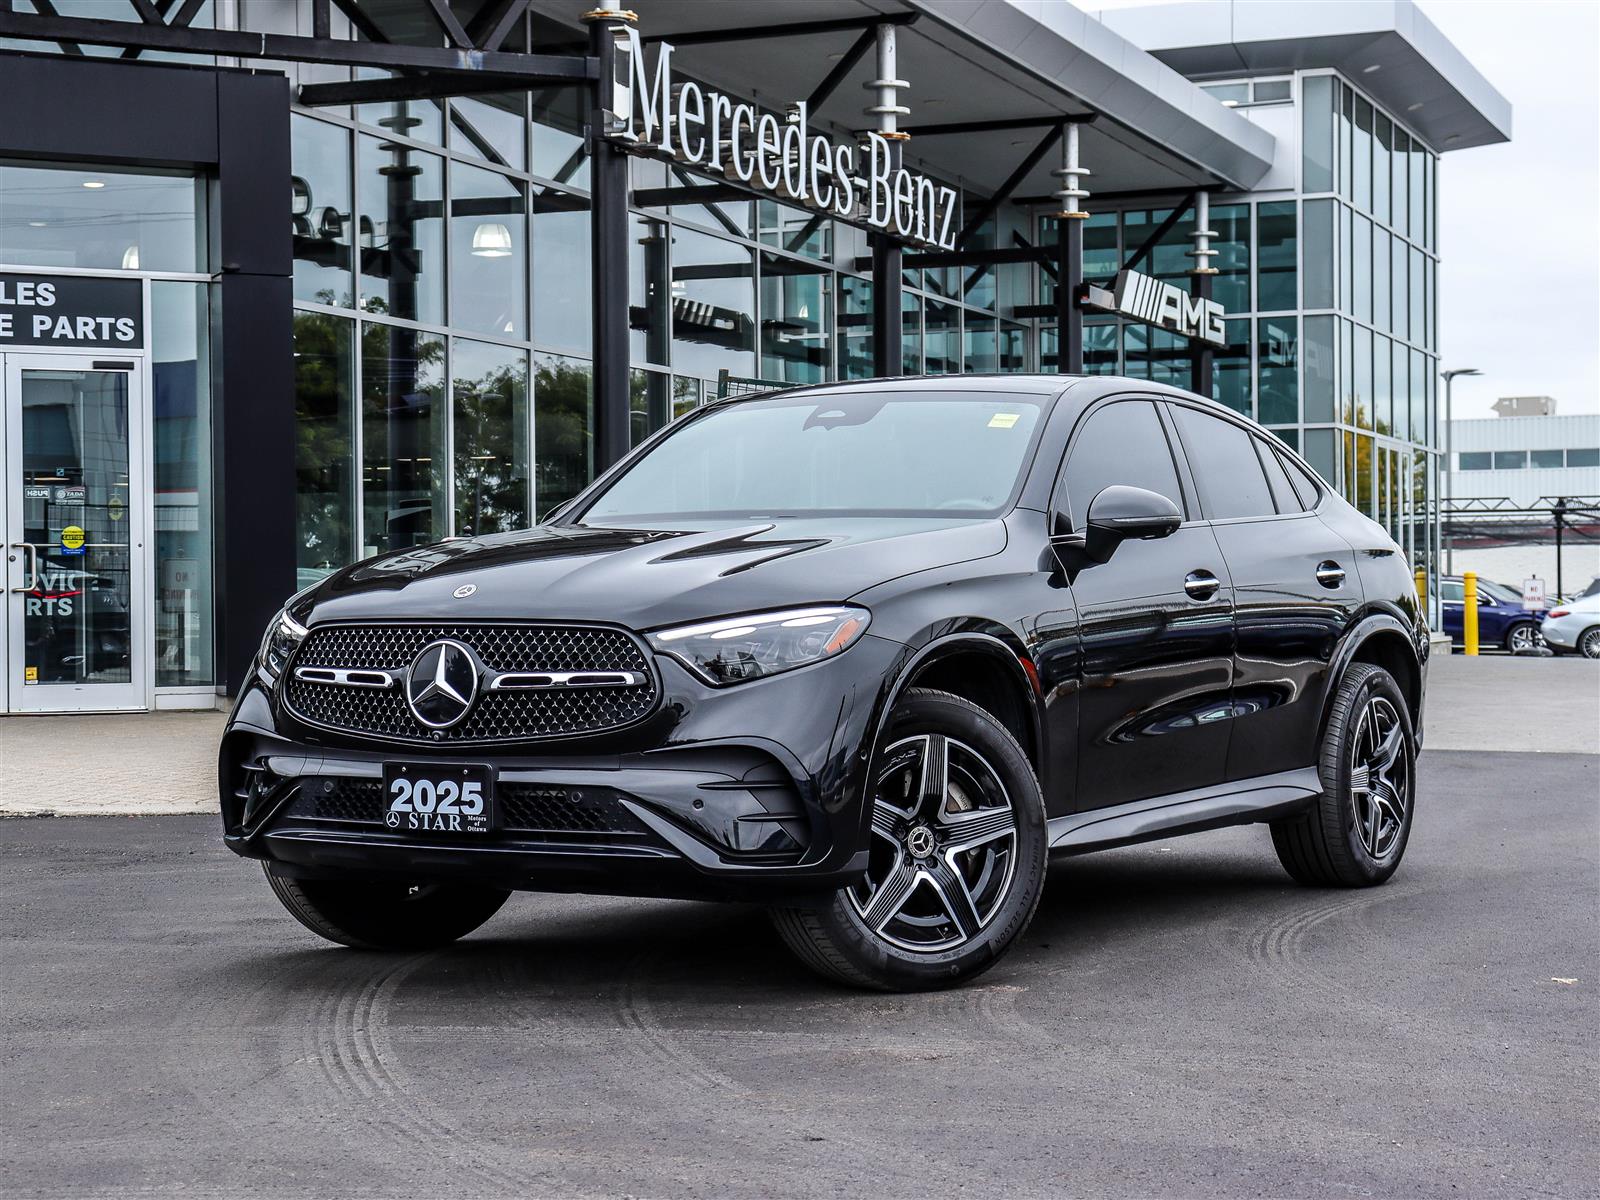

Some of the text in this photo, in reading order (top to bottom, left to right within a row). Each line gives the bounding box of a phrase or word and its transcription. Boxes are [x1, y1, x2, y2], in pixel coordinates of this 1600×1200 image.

[609, 24, 957, 250] Mercedes-Benz
[32, 314, 136, 341] PARTS
[1156, 283, 1225, 345] AMG
[26, 598, 73, 616] RTS
[390, 778, 484, 815] 2025
[408, 812, 462, 831] STAR
